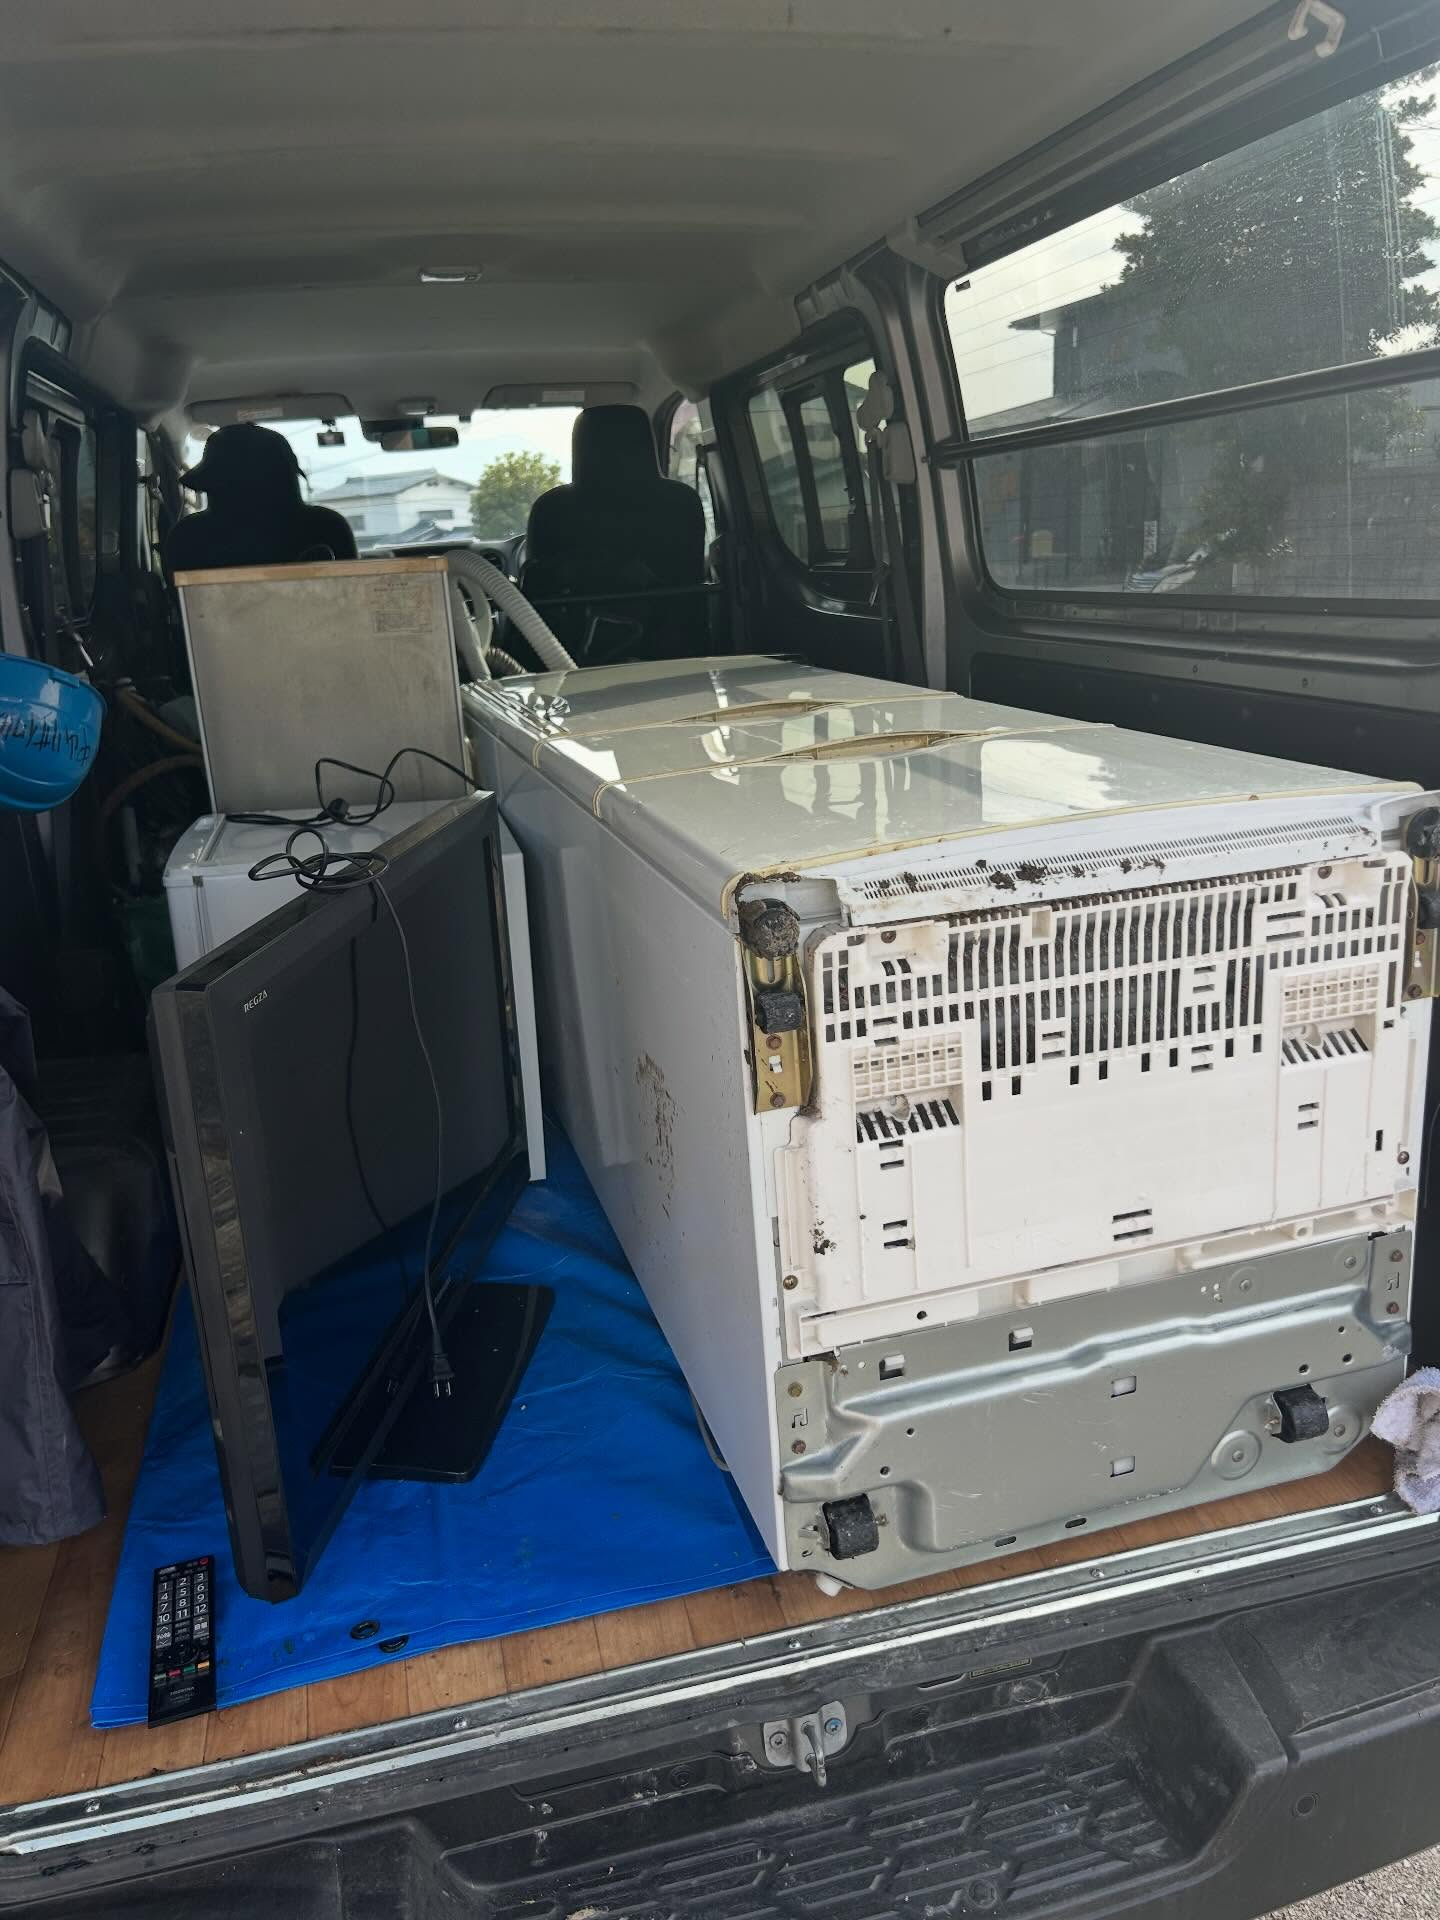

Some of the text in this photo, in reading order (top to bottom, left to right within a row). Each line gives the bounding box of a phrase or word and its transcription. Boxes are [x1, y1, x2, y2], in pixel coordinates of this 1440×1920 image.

[243, 989, 268, 1013] REGZA
[162, 1582, 168, 1590] 1
[198, 1584, 204, 1592] 6
[160, 1594, 204, 1612] 7 8 9
[158, 1603, 207, 1623] 10 11 12
